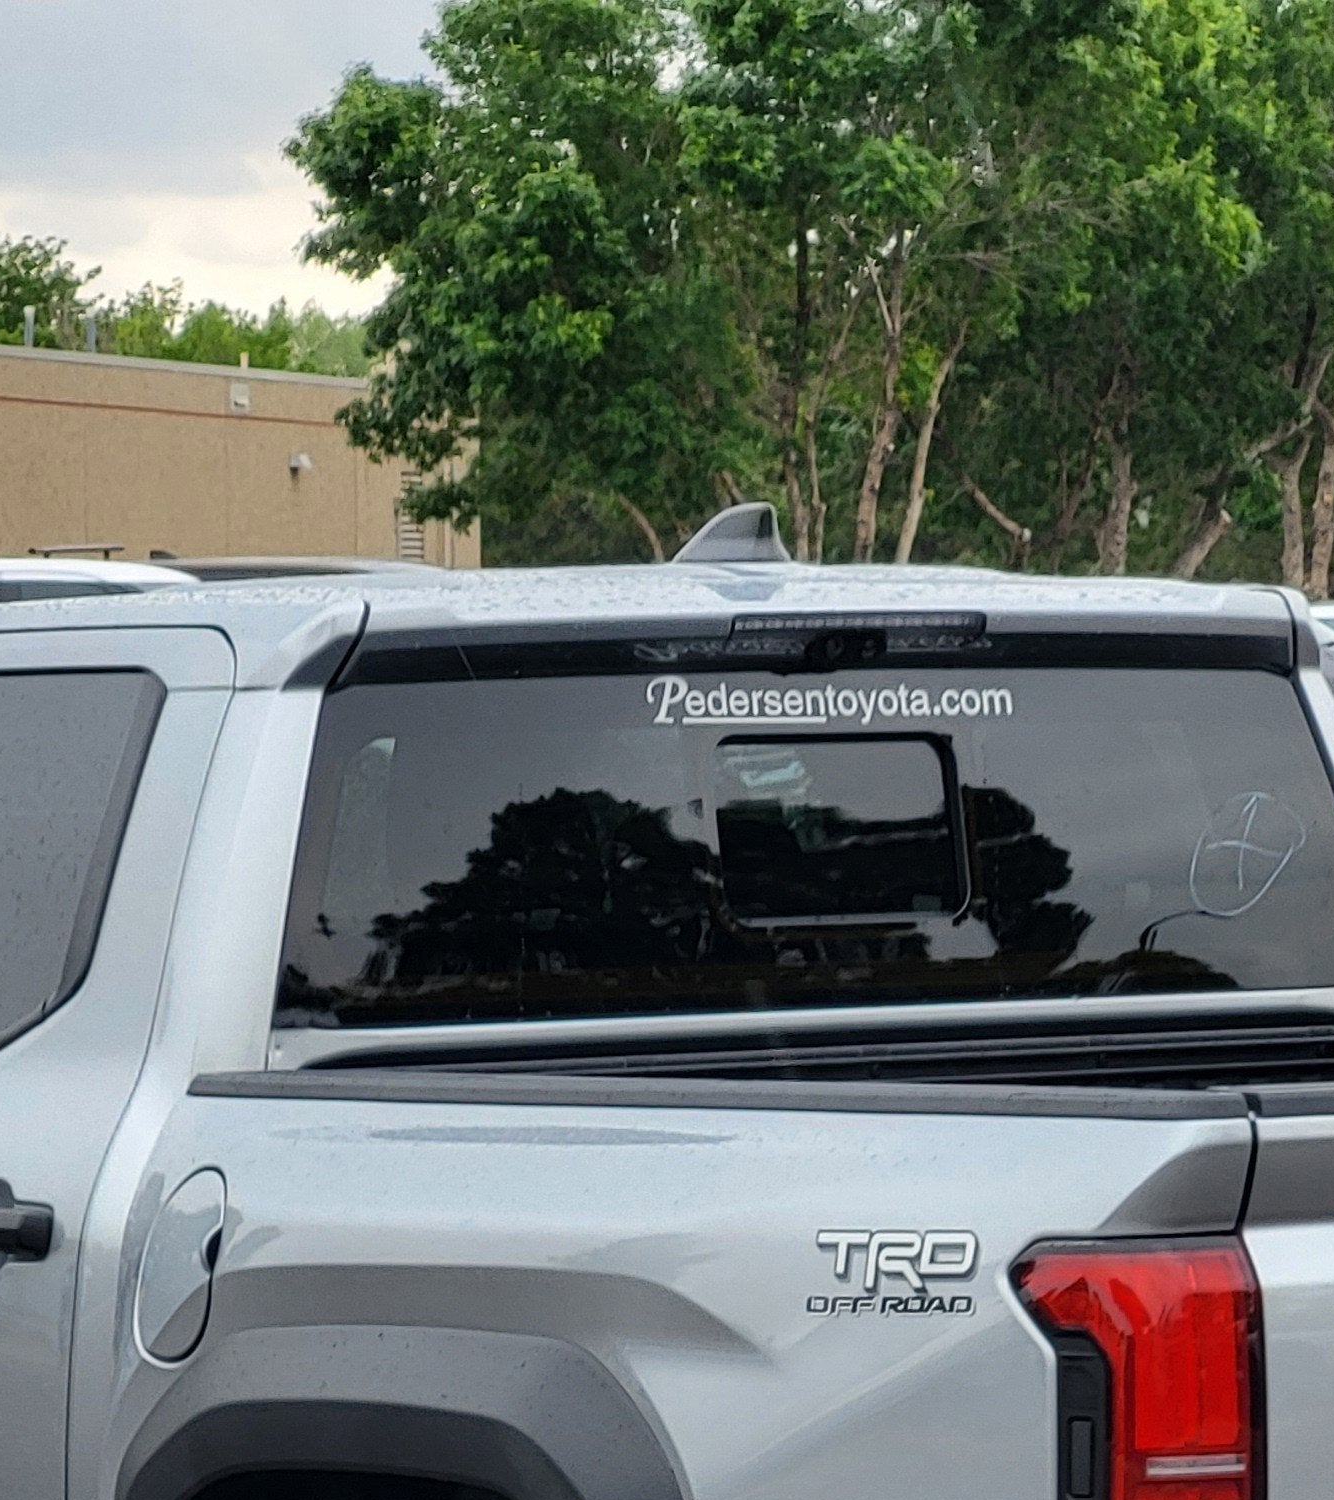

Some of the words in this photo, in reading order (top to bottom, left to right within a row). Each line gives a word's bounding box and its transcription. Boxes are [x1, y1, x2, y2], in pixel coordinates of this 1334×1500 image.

[646, 675, 1014, 724] Pedersentoyota.com
[816, 1229, 979, 1293] TRD
[806, 1296, 876, 1316] OFF
[880, 1296, 975, 1316] ROAD
